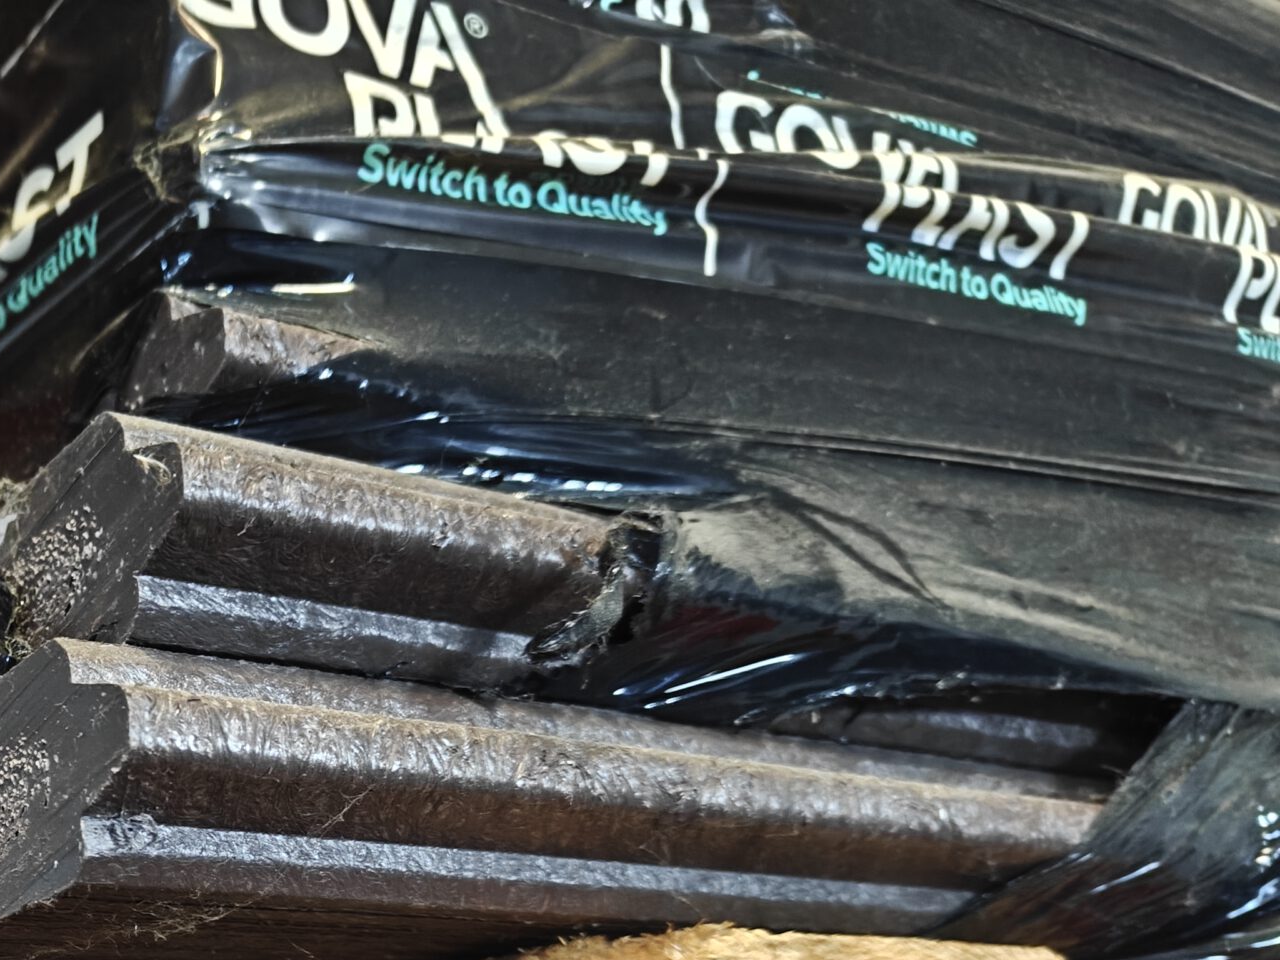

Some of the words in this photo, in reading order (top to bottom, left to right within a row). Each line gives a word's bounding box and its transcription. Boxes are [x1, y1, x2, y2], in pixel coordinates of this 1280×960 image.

[358, 143, 488, 202] Switch
[494, 172, 532, 209] to
[537, 180, 667, 236] Quality
[866, 242, 957, 294] Switch
[961, 266, 989, 300] to
[991, 273, 1087, 326] Quality
